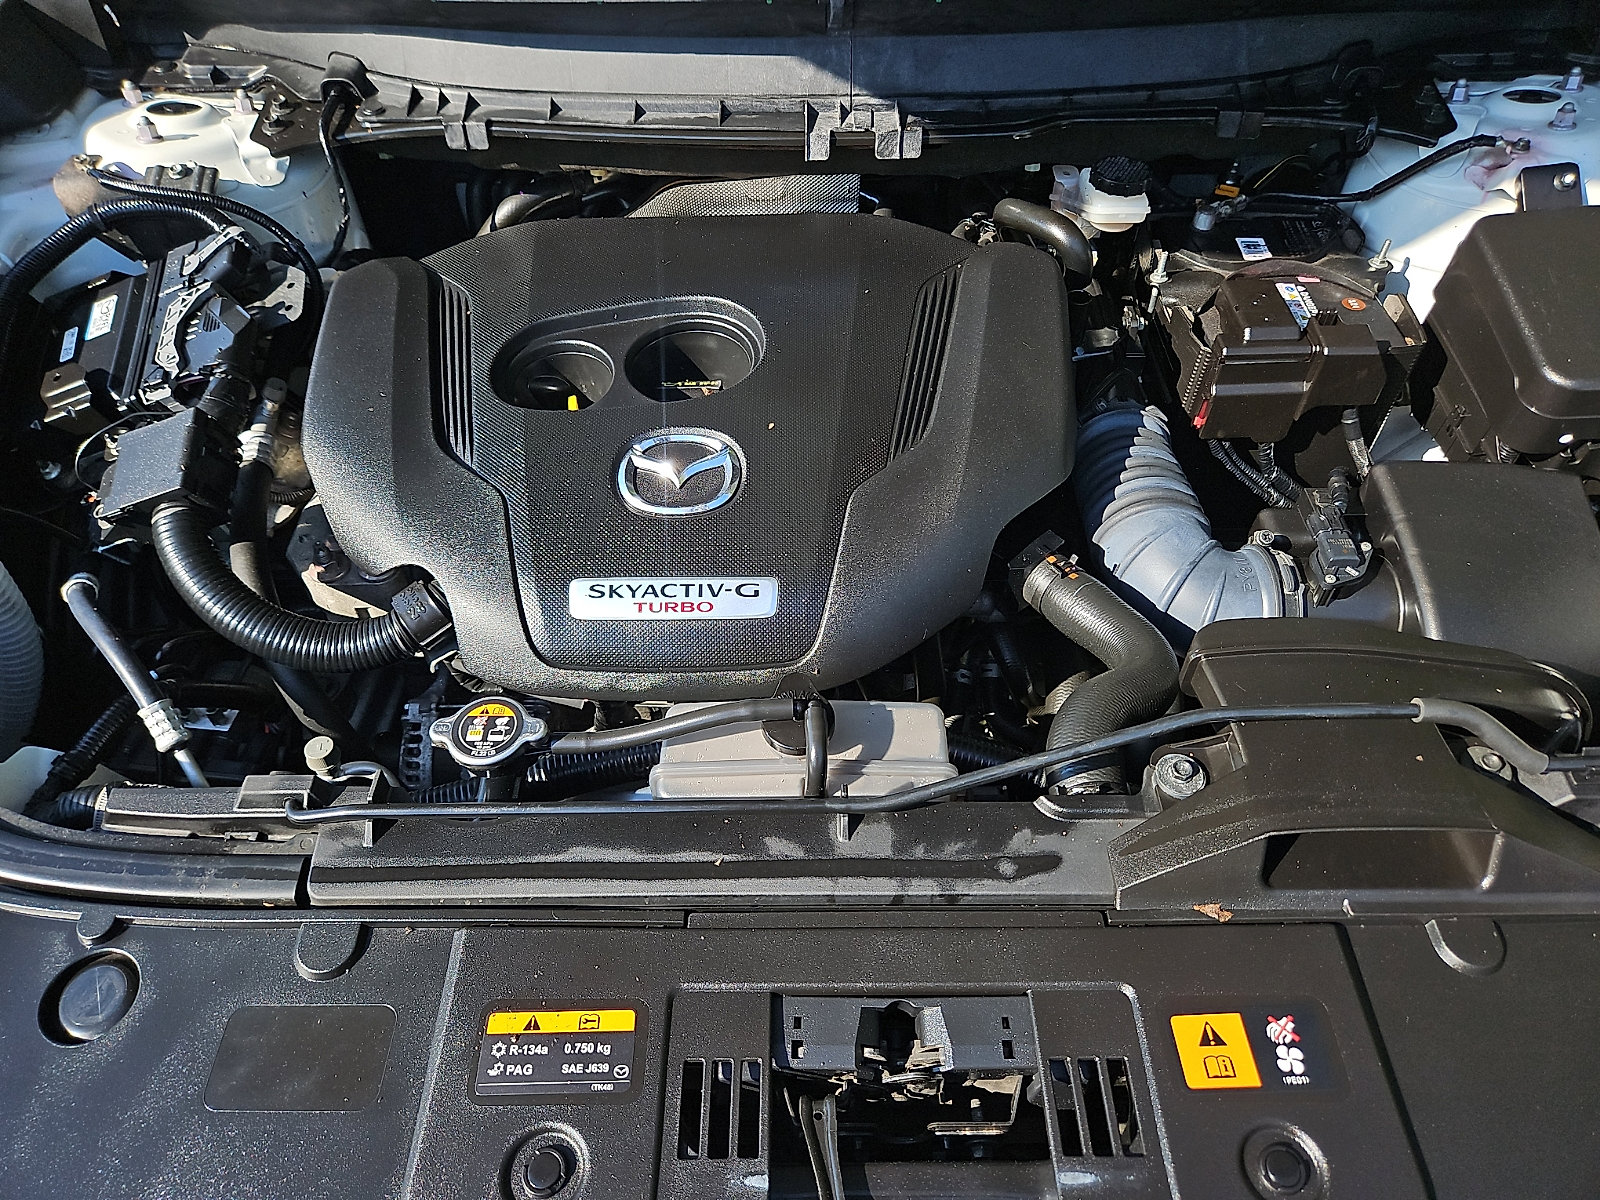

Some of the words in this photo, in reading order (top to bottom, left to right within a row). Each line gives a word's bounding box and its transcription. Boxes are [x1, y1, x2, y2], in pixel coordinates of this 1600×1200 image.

[588, 583, 760, 599] SKYACTIV-G
[633, 601, 714, 613] TURBO
[509, 1044, 549, 1056] R-134a
[564, 1042, 594, 1055] 0.750
[596, 1042, 611, 1056] kg
[506, 1064, 533, 1076] PAG
[561, 1064, 583, 1074] SAE
[585, 1063, 610, 1074] J639
